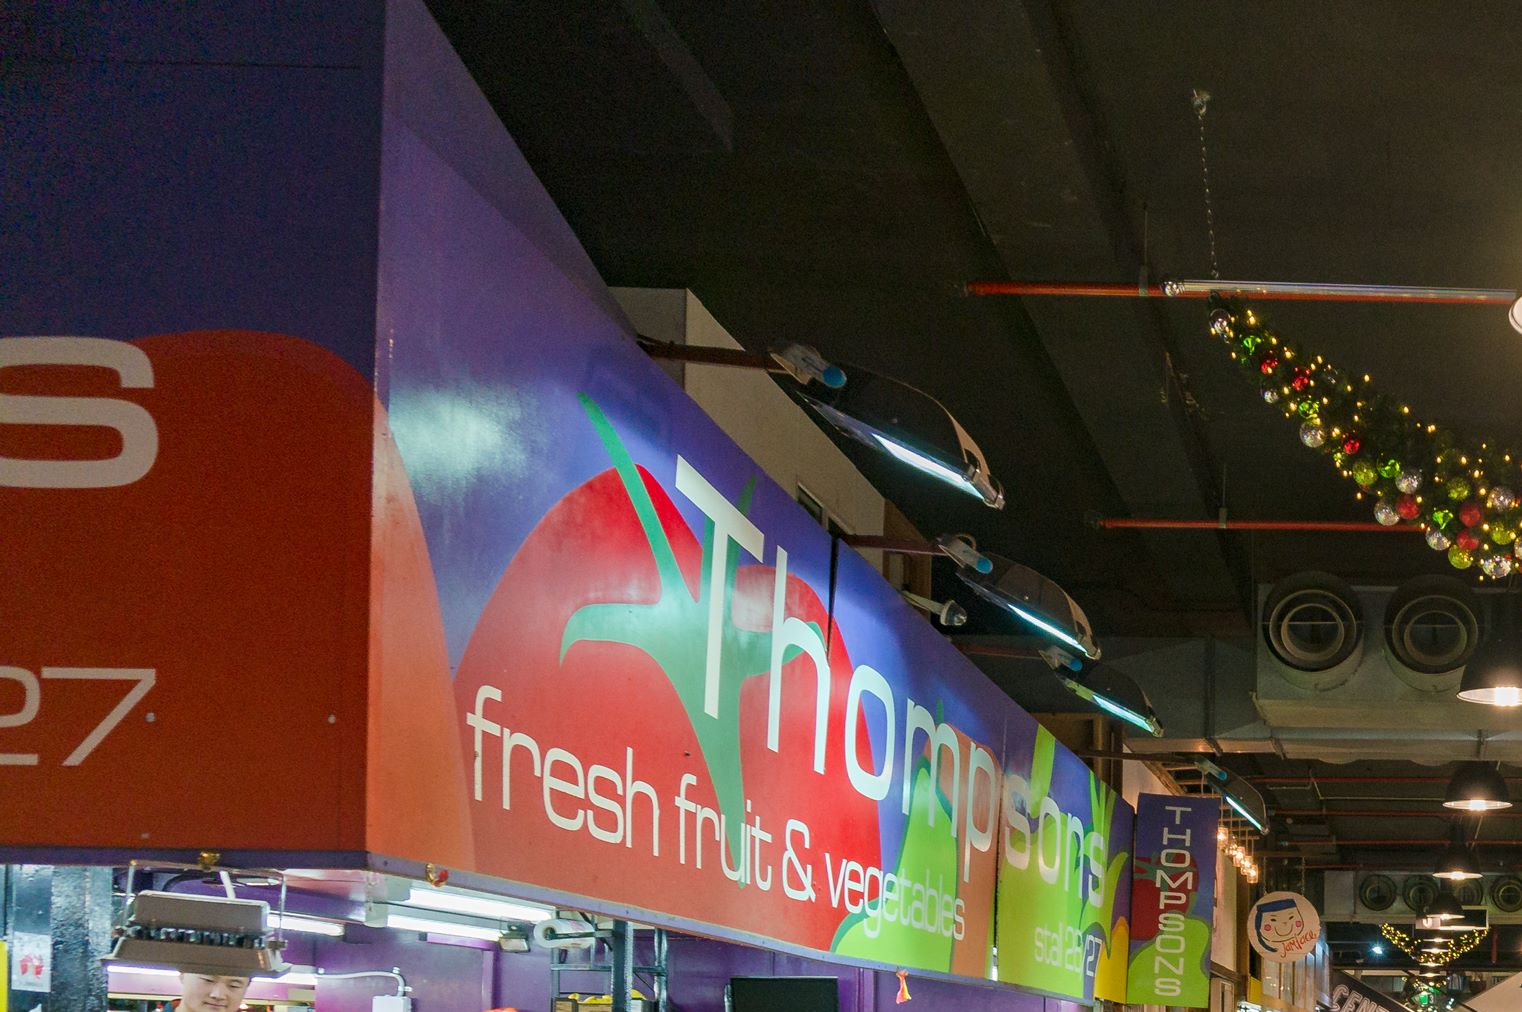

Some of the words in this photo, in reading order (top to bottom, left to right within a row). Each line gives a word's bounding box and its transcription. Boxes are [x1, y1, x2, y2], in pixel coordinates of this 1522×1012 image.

[675, 454, 1107, 908] Thompsons
[467, 685, 660, 857] fresh
[675, 773, 772, 891] fruit
[782, 820, 816, 904] &
[826, 851, 965, 941] vegetables
[1153, 806, 1193, 997] THOMPSONS
